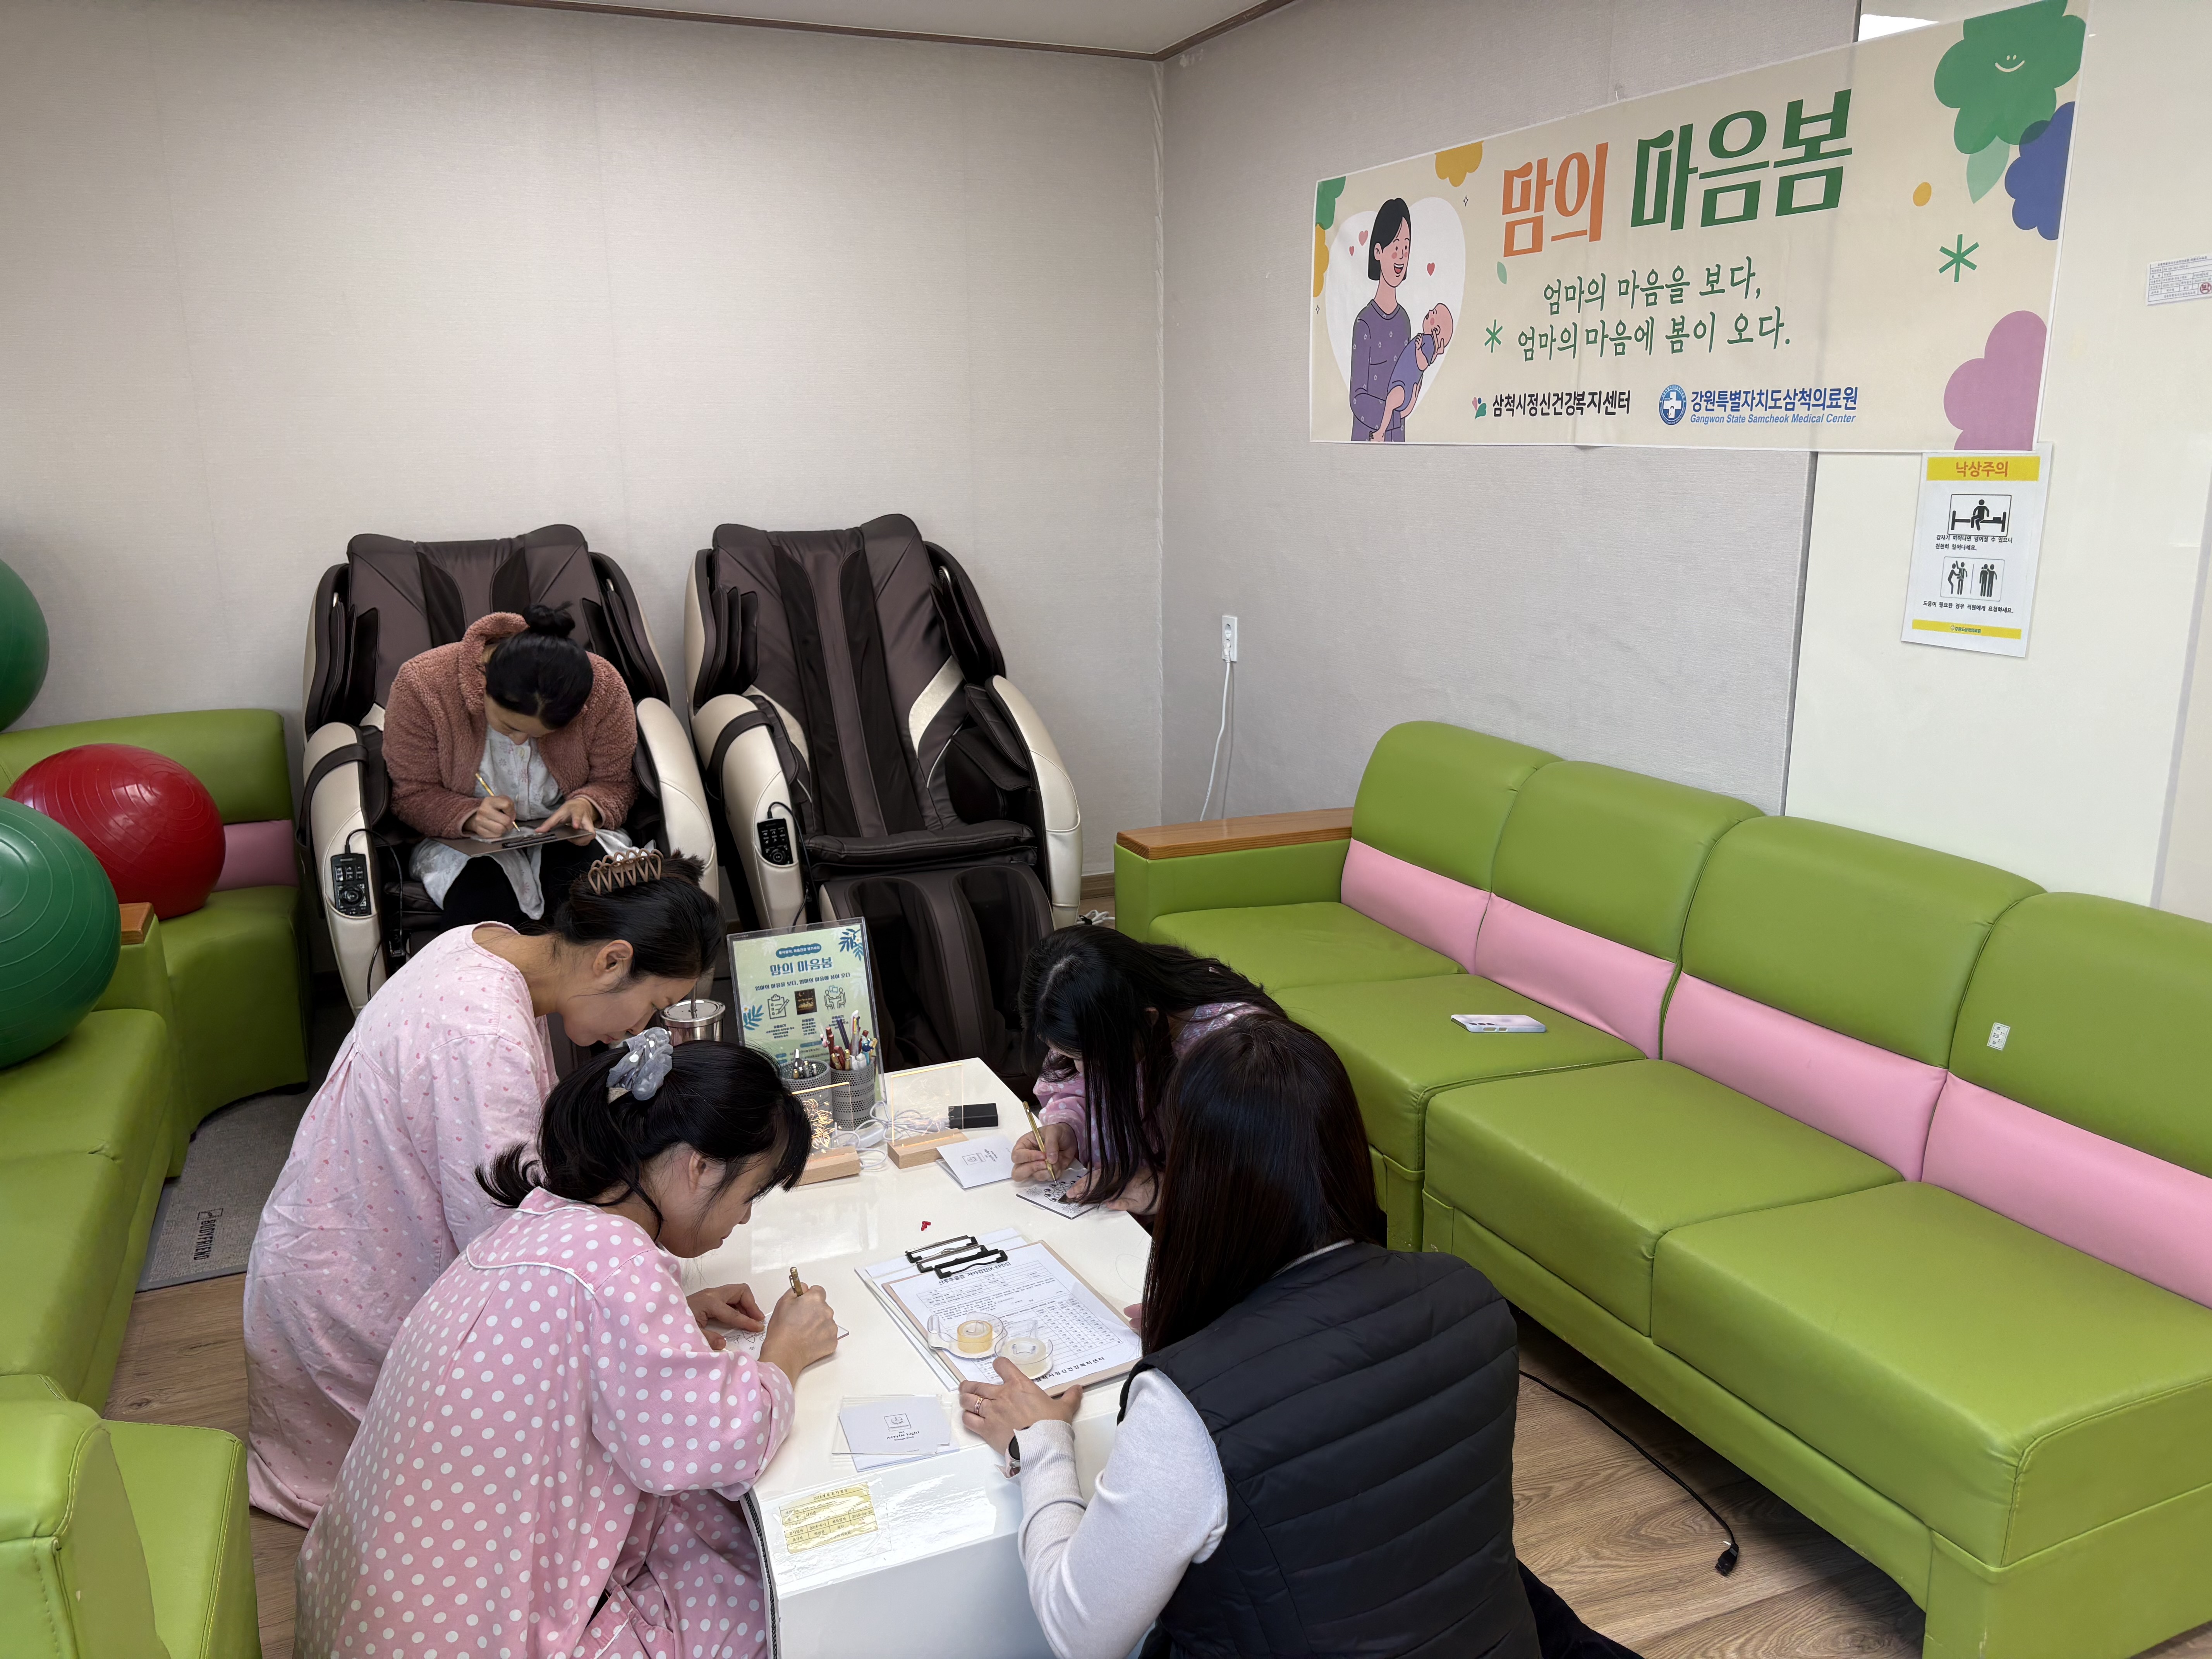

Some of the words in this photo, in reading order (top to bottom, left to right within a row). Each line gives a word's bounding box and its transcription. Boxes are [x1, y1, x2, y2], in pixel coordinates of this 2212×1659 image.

[1502, 142, 1608, 257] 맘의
[1631, 89, 1852, 230] 마음봄
[1544, 273, 1606, 315] 엄마의
[1618, 265, 1690, 308] 마음을
[1699, 256, 1761, 299] 보다,
[1518, 322, 1577, 361] 엄마의
[1585, 316, 1655, 357] 마음에
[1666, 311, 1715, 354] 봄이
[1727, 306, 1790, 349] 오다.
[1492, 390, 1630, 417] 삼척시정신건강복지센터
[1691, 386, 1858, 412] 강원특별자치도삼척의료원
[1690, 414, 1724, 425] Gangwon
[1726, 414, 1746, 423] State
[1748, 414, 1790, 423] Samcheok
[1791, 414, 1824, 423] Medical
[1826, 414, 1856, 423] Center
[1956, 461, 2008, 477] 낙상주의
[770, 962, 793, 976] 맘의
[797, 957, 833, 972] 마음봄
[194, 1219, 216, 1260] BODYFRIEND
